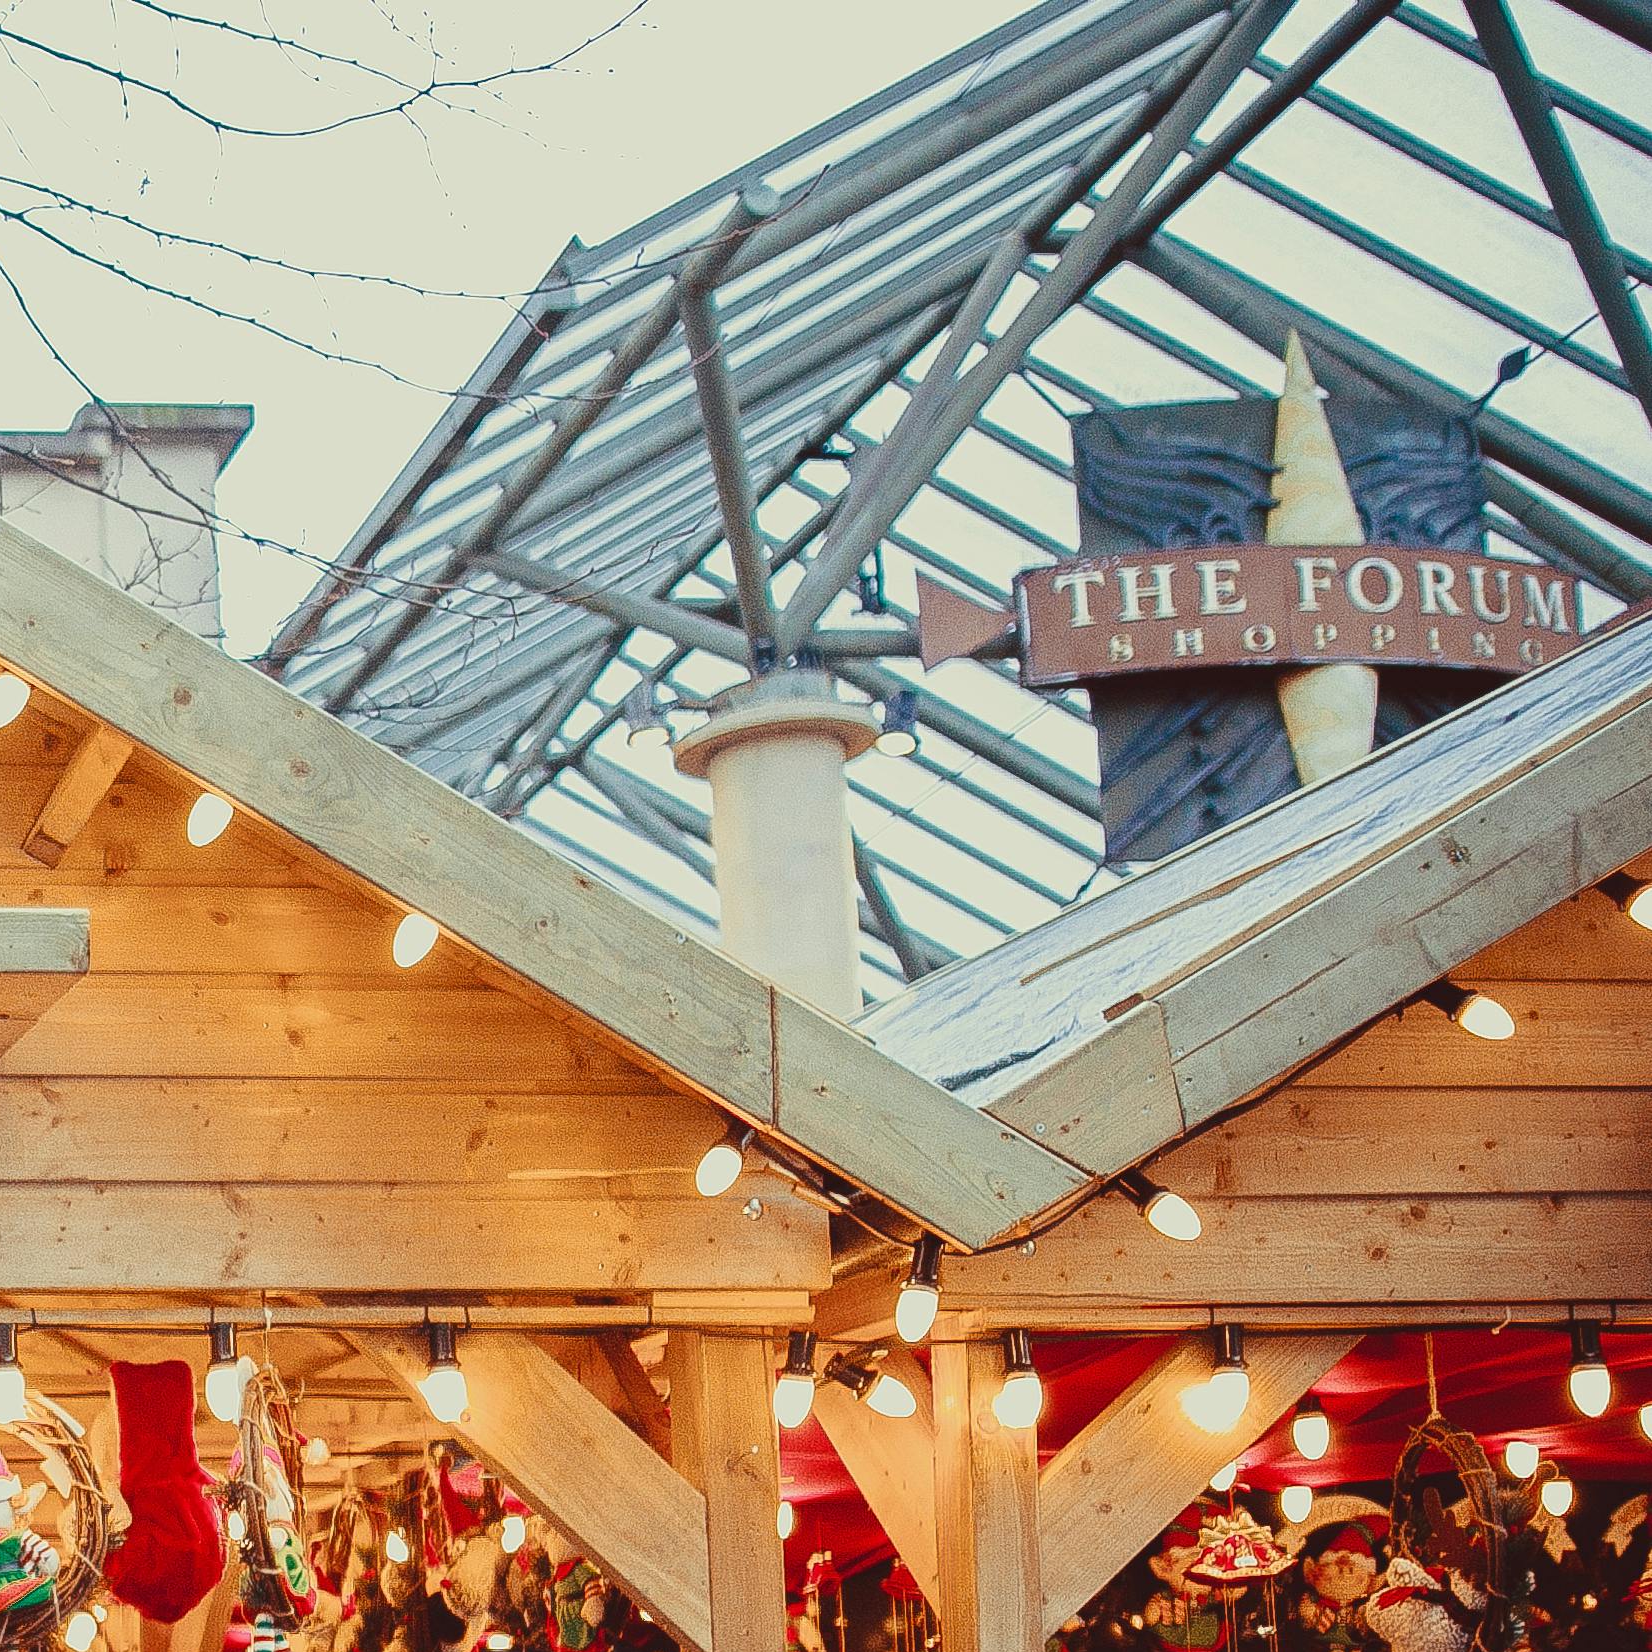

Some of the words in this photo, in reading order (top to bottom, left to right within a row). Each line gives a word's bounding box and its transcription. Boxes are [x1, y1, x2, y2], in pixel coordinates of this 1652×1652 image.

[1050, 558, 1249, 630] THE
[1294, 556, 1572, 634] FORUM
[1106, 623, 1546, 665] SHOPPING
